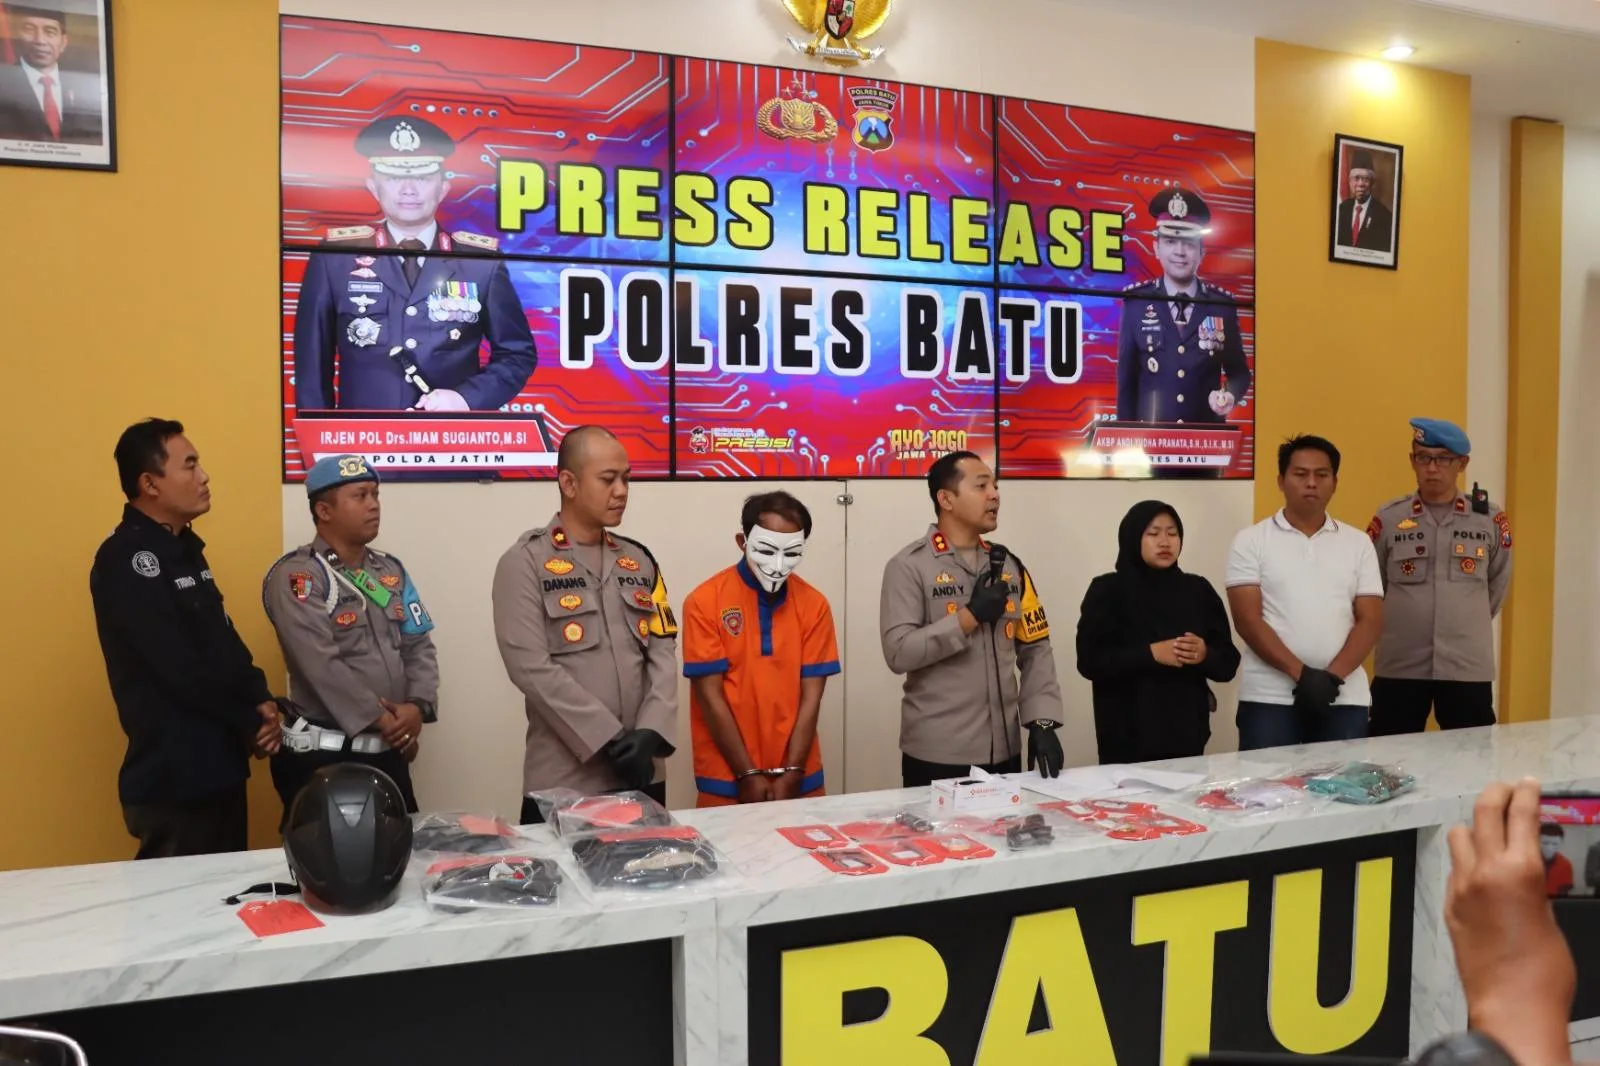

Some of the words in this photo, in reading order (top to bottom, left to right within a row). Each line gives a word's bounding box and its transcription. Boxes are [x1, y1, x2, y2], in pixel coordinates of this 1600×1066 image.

[878, 91, 896, 101] BATU
[497, 158, 775, 250] PRESS
[803, 181, 1126, 274] RELEASE
[562, 270, 870, 377] POLRES
[901, 288, 1083, 384] BATU
[320, 431, 355, 445] IRJEN
[358, 432, 383, 444] POL
[386, 432, 439, 445] Drs.IMAM
[442, 432, 527, 446] SUGIANTO,M.SI
[715, 437, 793, 448] PRESISI
[891, 429, 924, 452] AYO
[928, 429, 968, 451] JOGO
[1096, 437, 1114, 447] AKBP
[363, 455, 436, 463] POLDA
[450, 455, 505, 463] JATIM
[896, 450, 926, 460] JAWA
[1394, 532, 1425, 542] NICO
[1453, 531, 1487, 541] POLRI
[543, 577, 587, 592] DANANG
[932, 585, 956, 597] ANDI
[958, 585, 965, 595] Y
[781, 856, 1394, 1066] BATU
